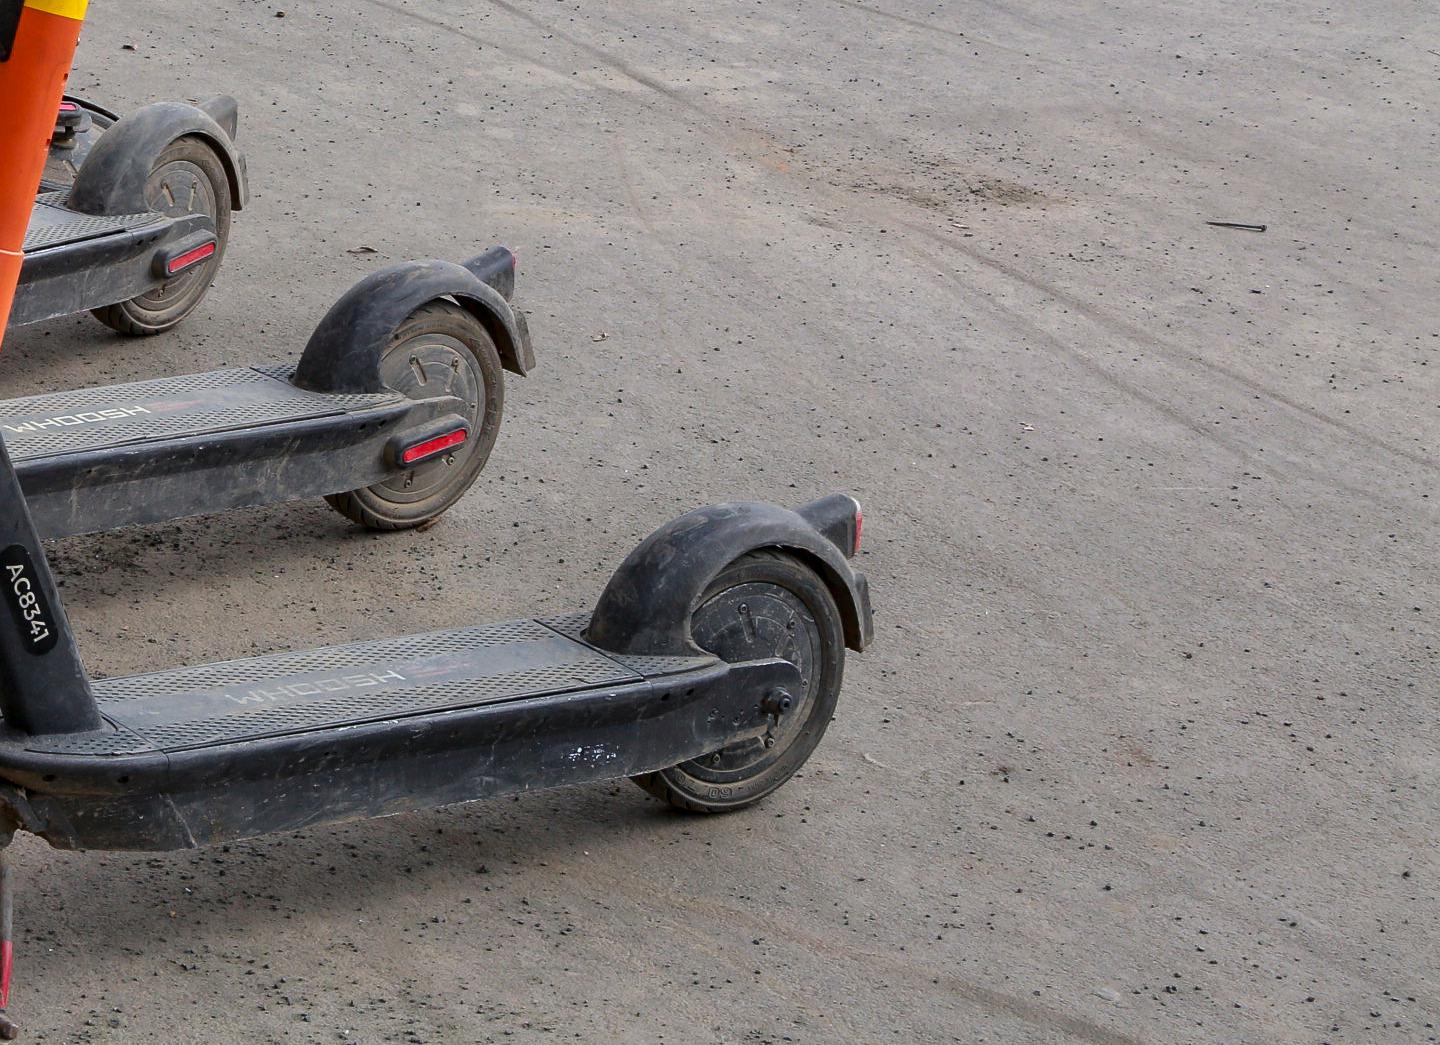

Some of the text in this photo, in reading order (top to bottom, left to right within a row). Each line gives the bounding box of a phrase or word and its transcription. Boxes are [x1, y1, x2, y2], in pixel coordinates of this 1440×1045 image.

[3, 405, 151, 433] WHOOSH
[5, 564, 50, 642] AC8341
[225, 670, 406, 704] WHOOSH
